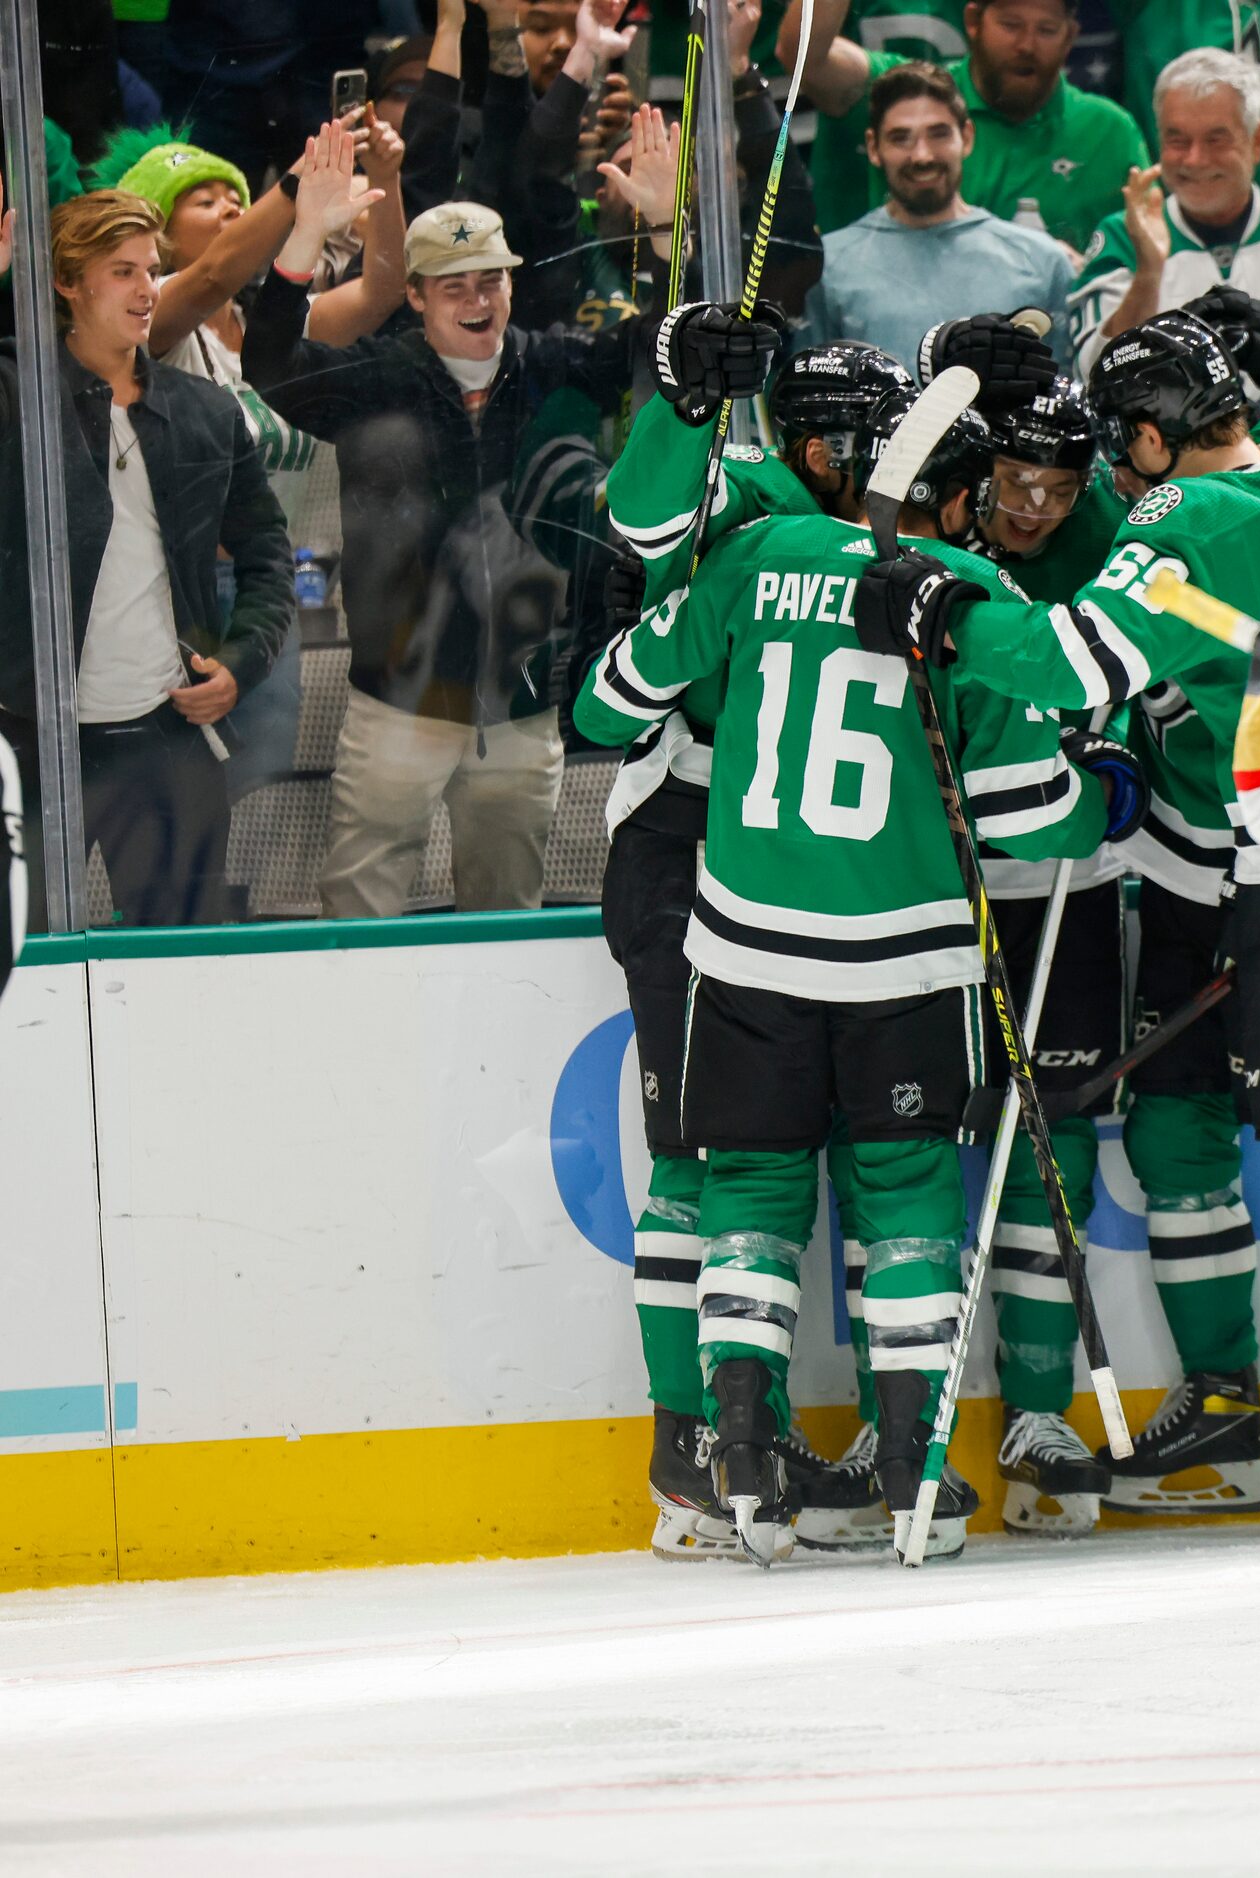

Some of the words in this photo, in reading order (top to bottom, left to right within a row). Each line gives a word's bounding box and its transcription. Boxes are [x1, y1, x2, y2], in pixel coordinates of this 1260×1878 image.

[1112, 341, 1142, 359] ENERGY
[1112, 349, 1151, 367] TRANSFER
[807, 364, 851, 377] TRANSFER
[1205, 356, 1231, 385] 55
[1032, 395, 1058, 416] 21
[717, 398, 733, 437] ALPHA
[1017, 429, 1060, 446] CCM
[841, 546, 876, 557] adidas
[741, 641, 910, 842] 16
[991, 986, 1020, 1064] SUPER
